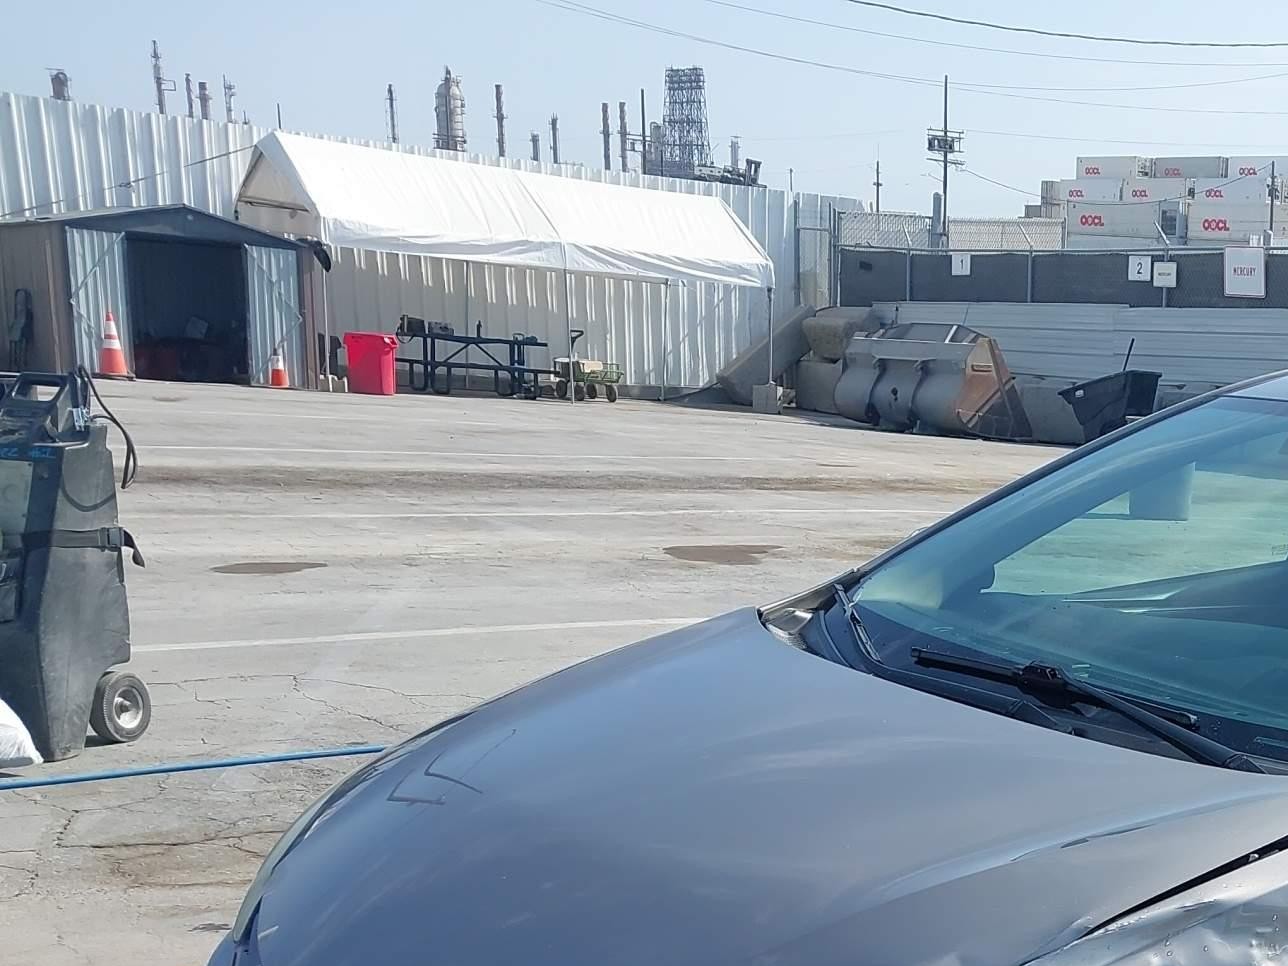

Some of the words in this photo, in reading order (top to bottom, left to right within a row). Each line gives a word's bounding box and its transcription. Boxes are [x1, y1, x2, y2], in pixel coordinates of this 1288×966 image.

[1085, 167, 1101, 175] OOCL
[1239, 167, 1258, 176] OOCL
[1069, 190, 1085, 198] OOCL
[1132, 190, 1148, 198] OOCL
[1205, 189, 1223, 198] OOCL
[1080, 215, 1104, 226] OOCL
[1203, 219, 1230, 231] OOCL
[1136, 261, 1143, 275] 2
[1233, 266, 1257, 276] MERCURY
